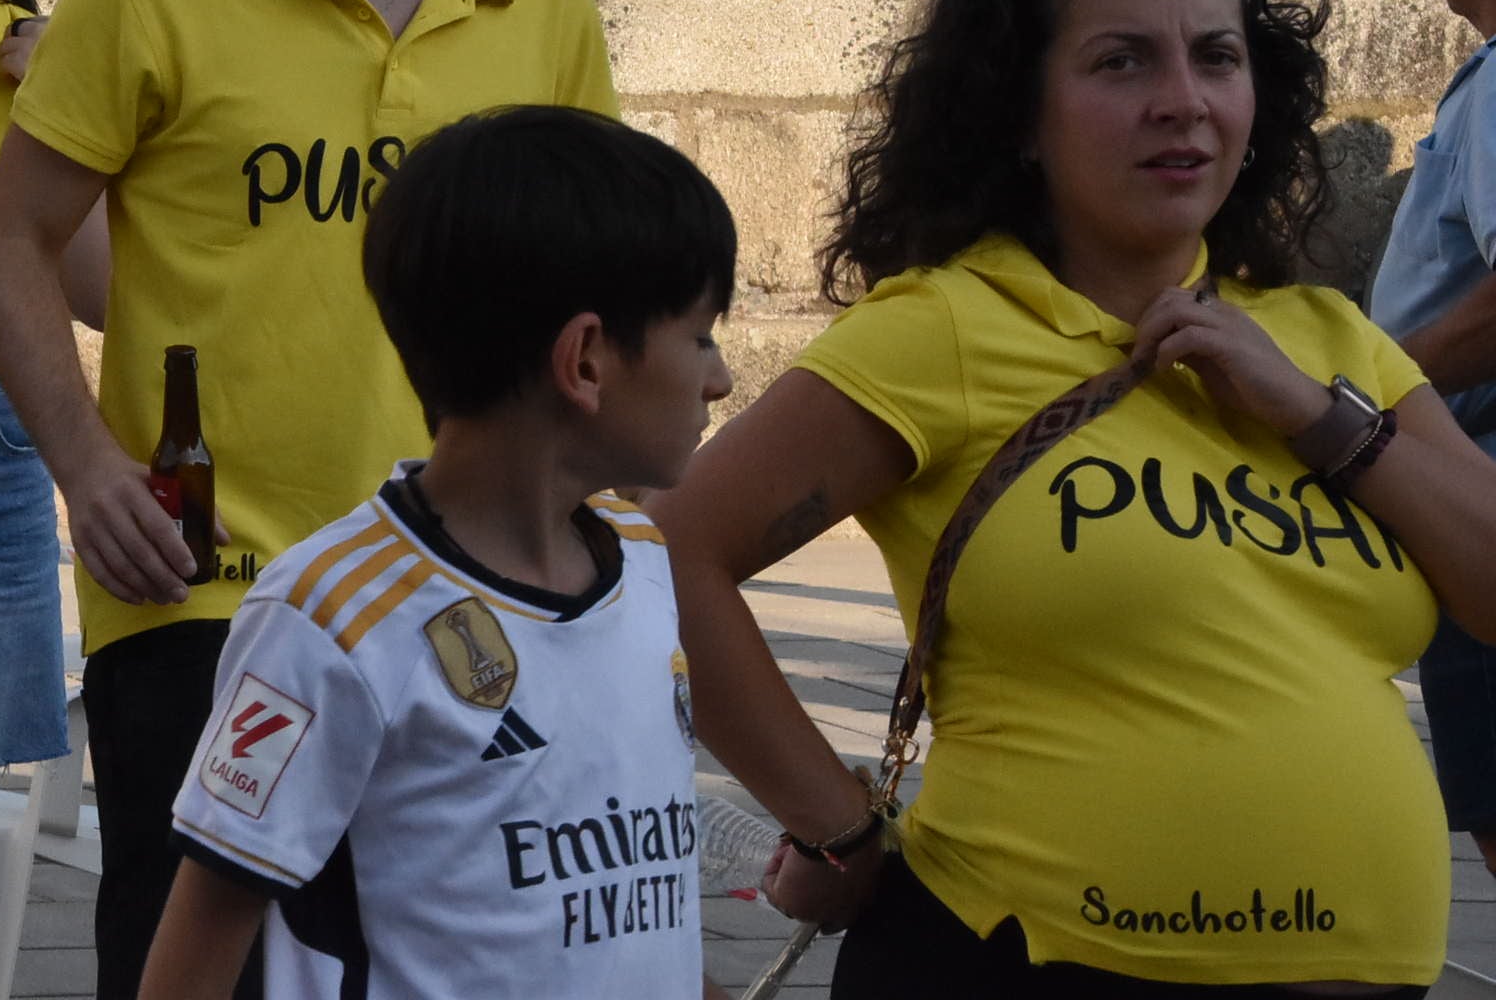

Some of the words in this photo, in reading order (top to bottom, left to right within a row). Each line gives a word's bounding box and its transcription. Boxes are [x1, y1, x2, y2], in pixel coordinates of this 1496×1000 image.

[208, 755, 260, 798] LALIGA
[562, 882, 619, 948] FLY
[1080, 886, 1336, 934] Sanchotello
